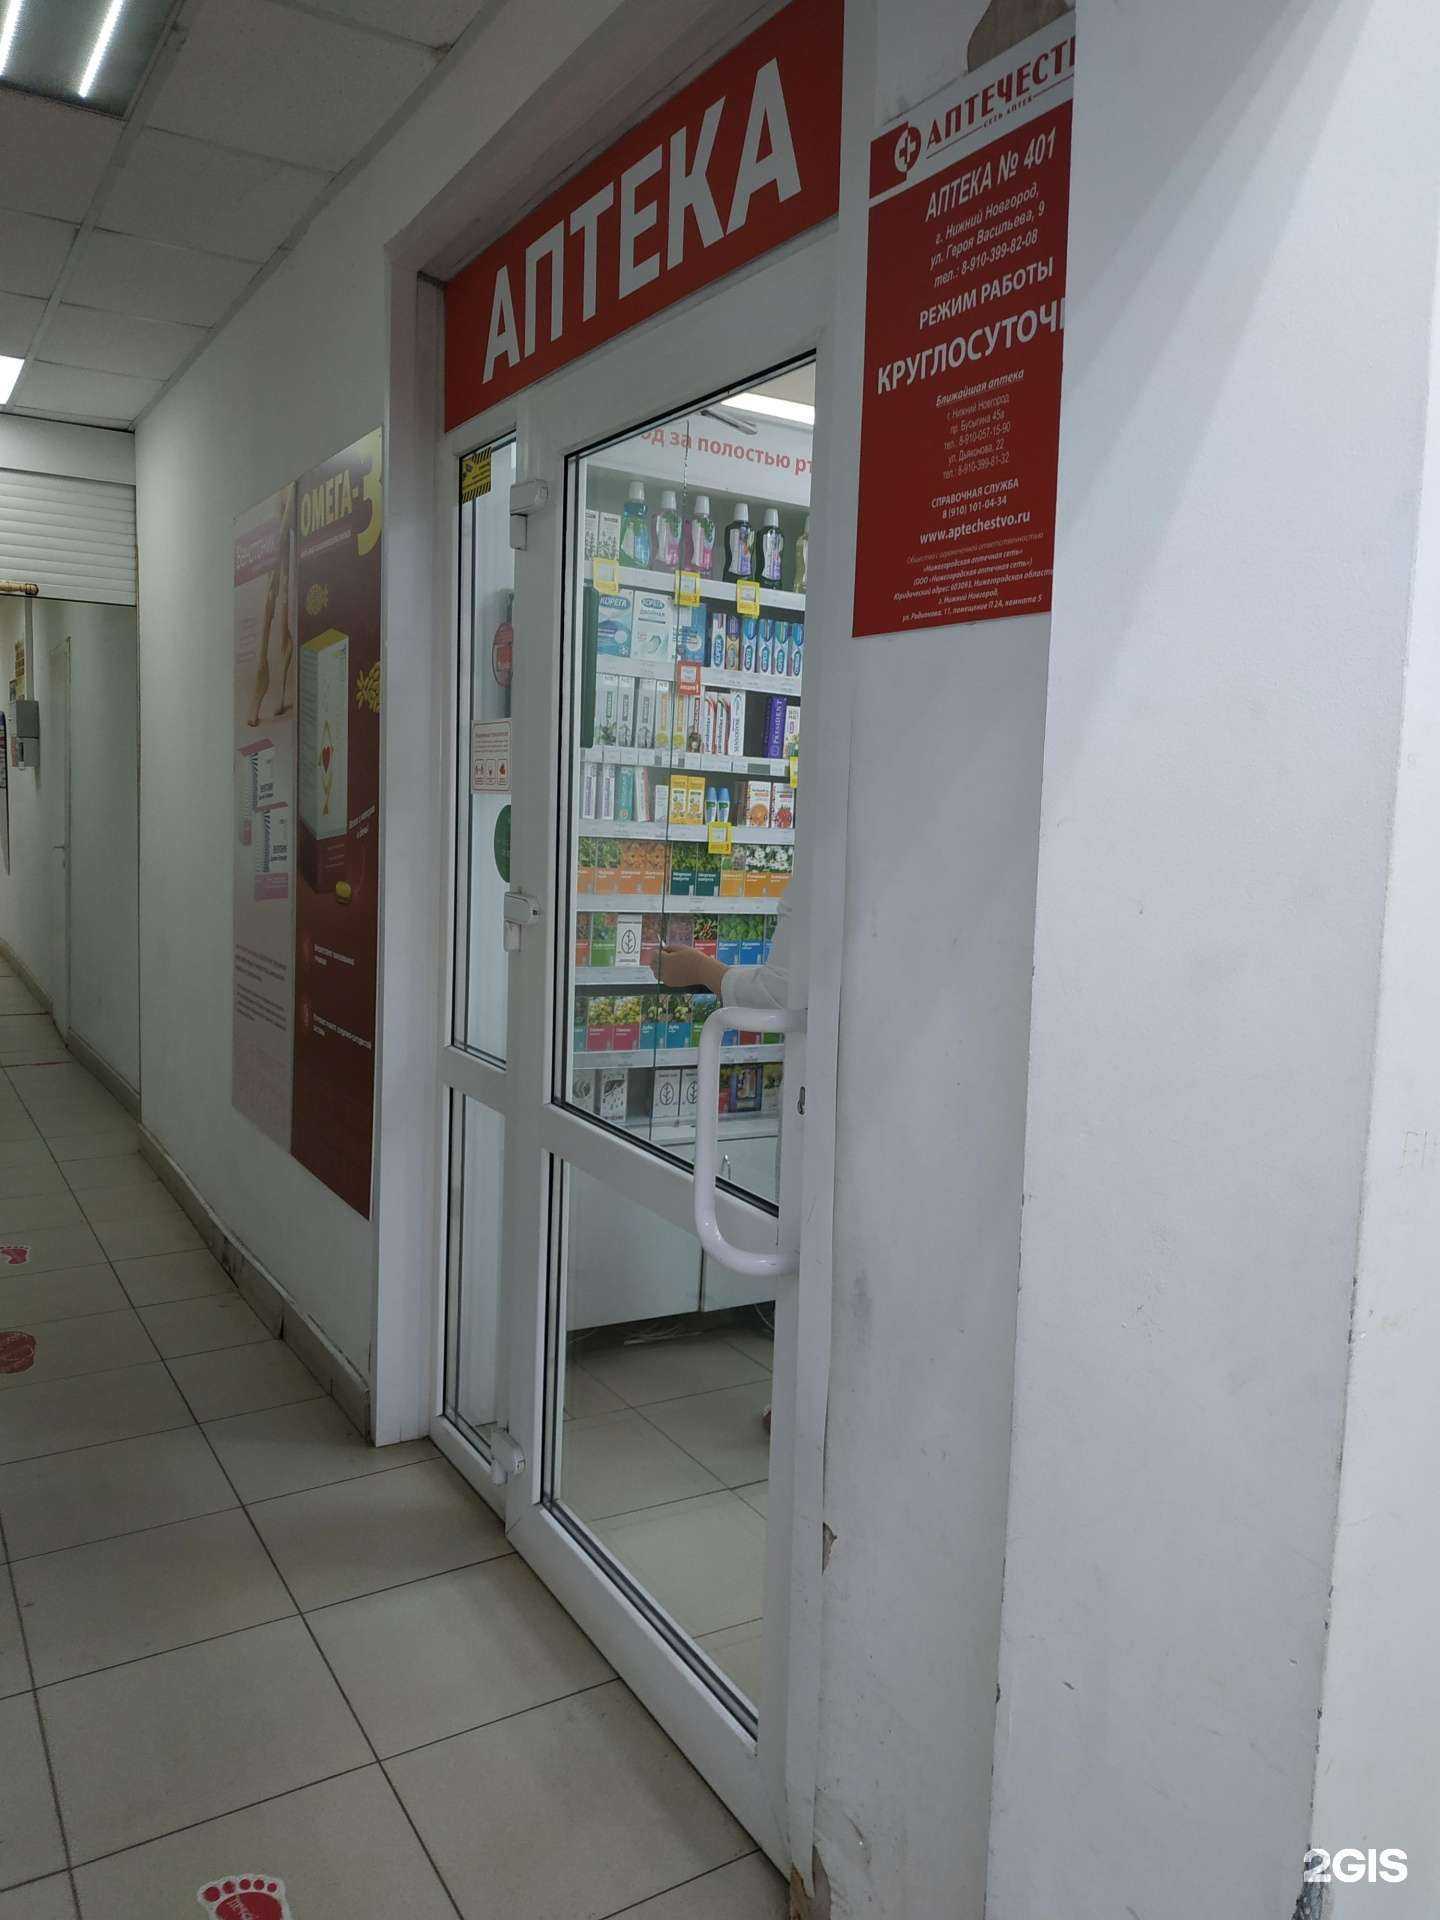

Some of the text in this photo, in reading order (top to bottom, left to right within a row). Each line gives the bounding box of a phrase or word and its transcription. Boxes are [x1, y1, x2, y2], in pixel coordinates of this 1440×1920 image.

[925, 126, 1056, 223] АПТЕКА № 401
[482, 56, 802, 385] АПТЕКА
[945, 209, 983, 240] Нижний
[985, 181, 1040, 220] Новгород,
[930, 200, 1047, 271] ул. Героя Васильева, 9
[961, 228, 1039, 276] 8-910-399-82-08
[919, 256, 1054, 331] РЕЖИМ РАБОТЫ
[988, 369, 1025, 390] аптека
[669, 431, 692, 449] за
[697, 436, 791, 469] полостью
[931, 478, 1019, 509] СПРАВОЧНАЯ СЛУЖБА
[948, 504, 968, 519] (910)
[968, 495, 1008, 514] 101-04-34
[919, 511, 1031, 545] www.aptechestvo.ru
